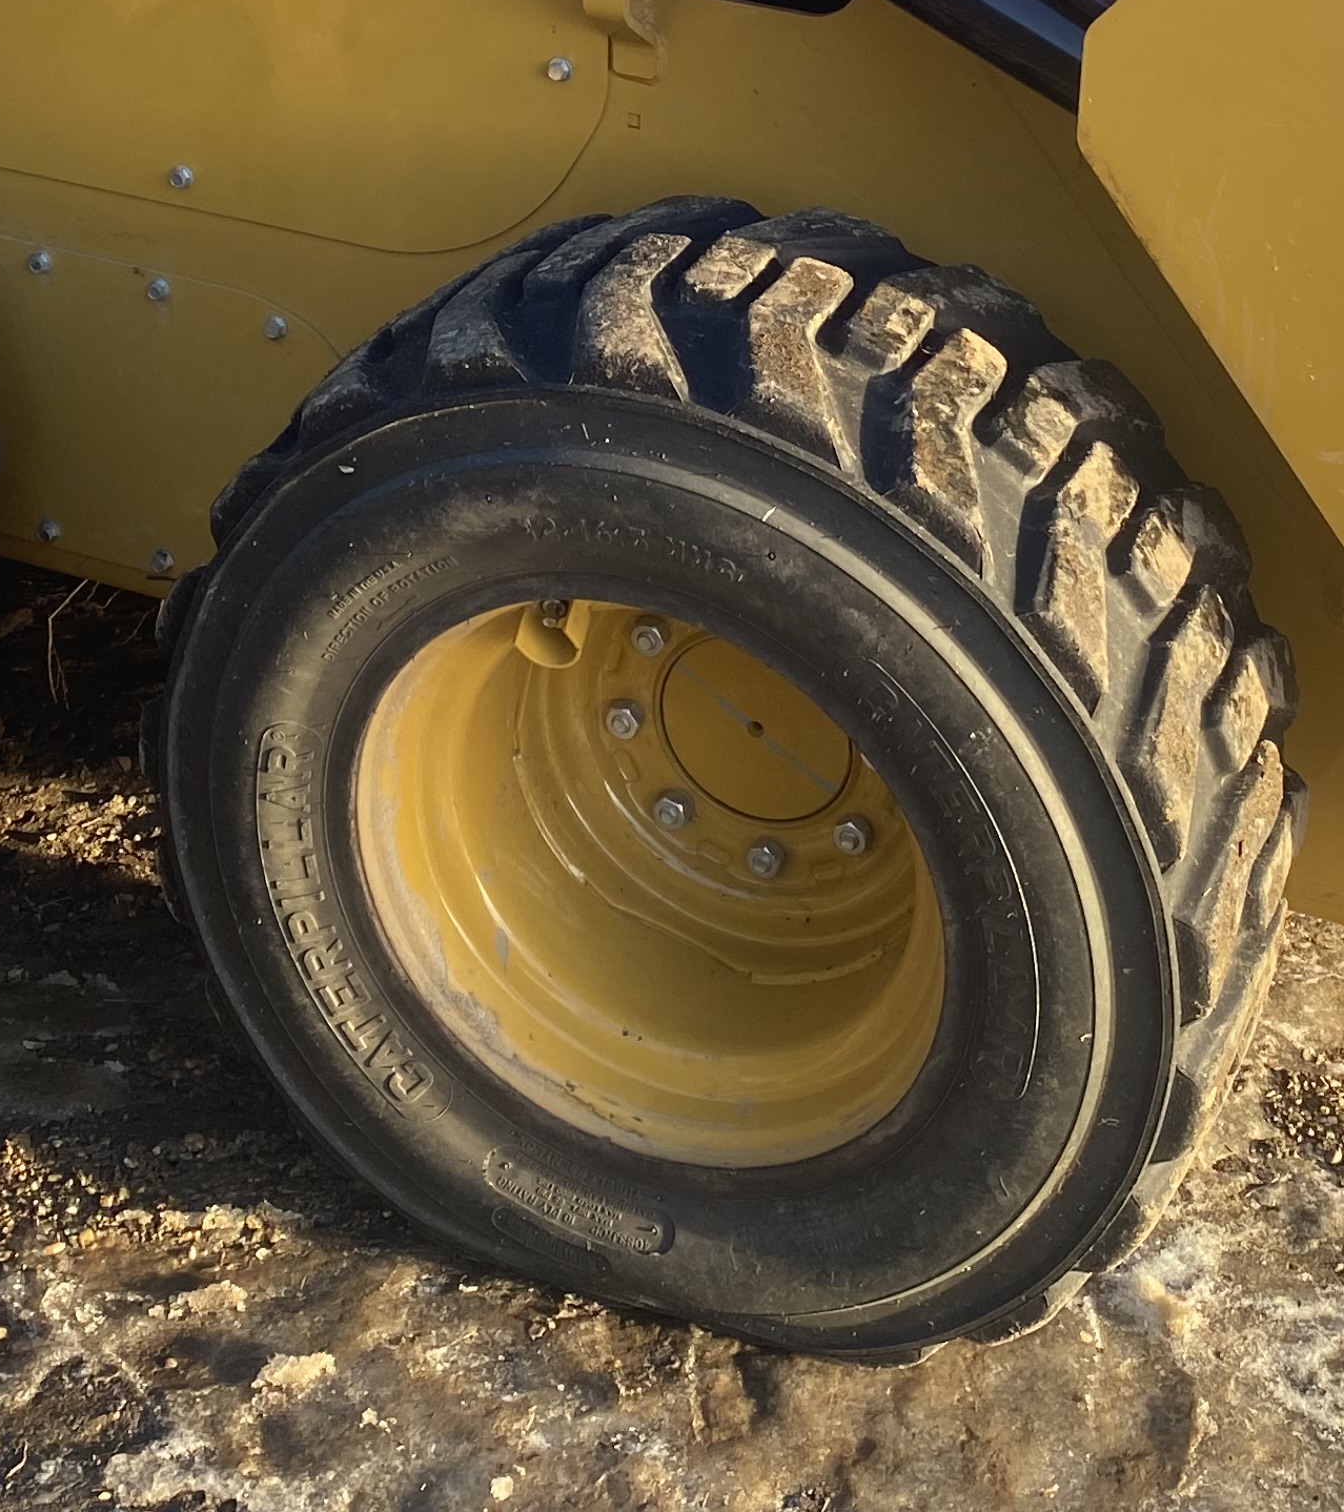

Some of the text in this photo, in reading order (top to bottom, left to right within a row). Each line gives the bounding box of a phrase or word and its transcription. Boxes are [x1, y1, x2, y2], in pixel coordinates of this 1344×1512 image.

[320, 554, 458, 662] DIRECTION OF ROTATION
[264, 744, 434, 1105] CATERPILLAR
